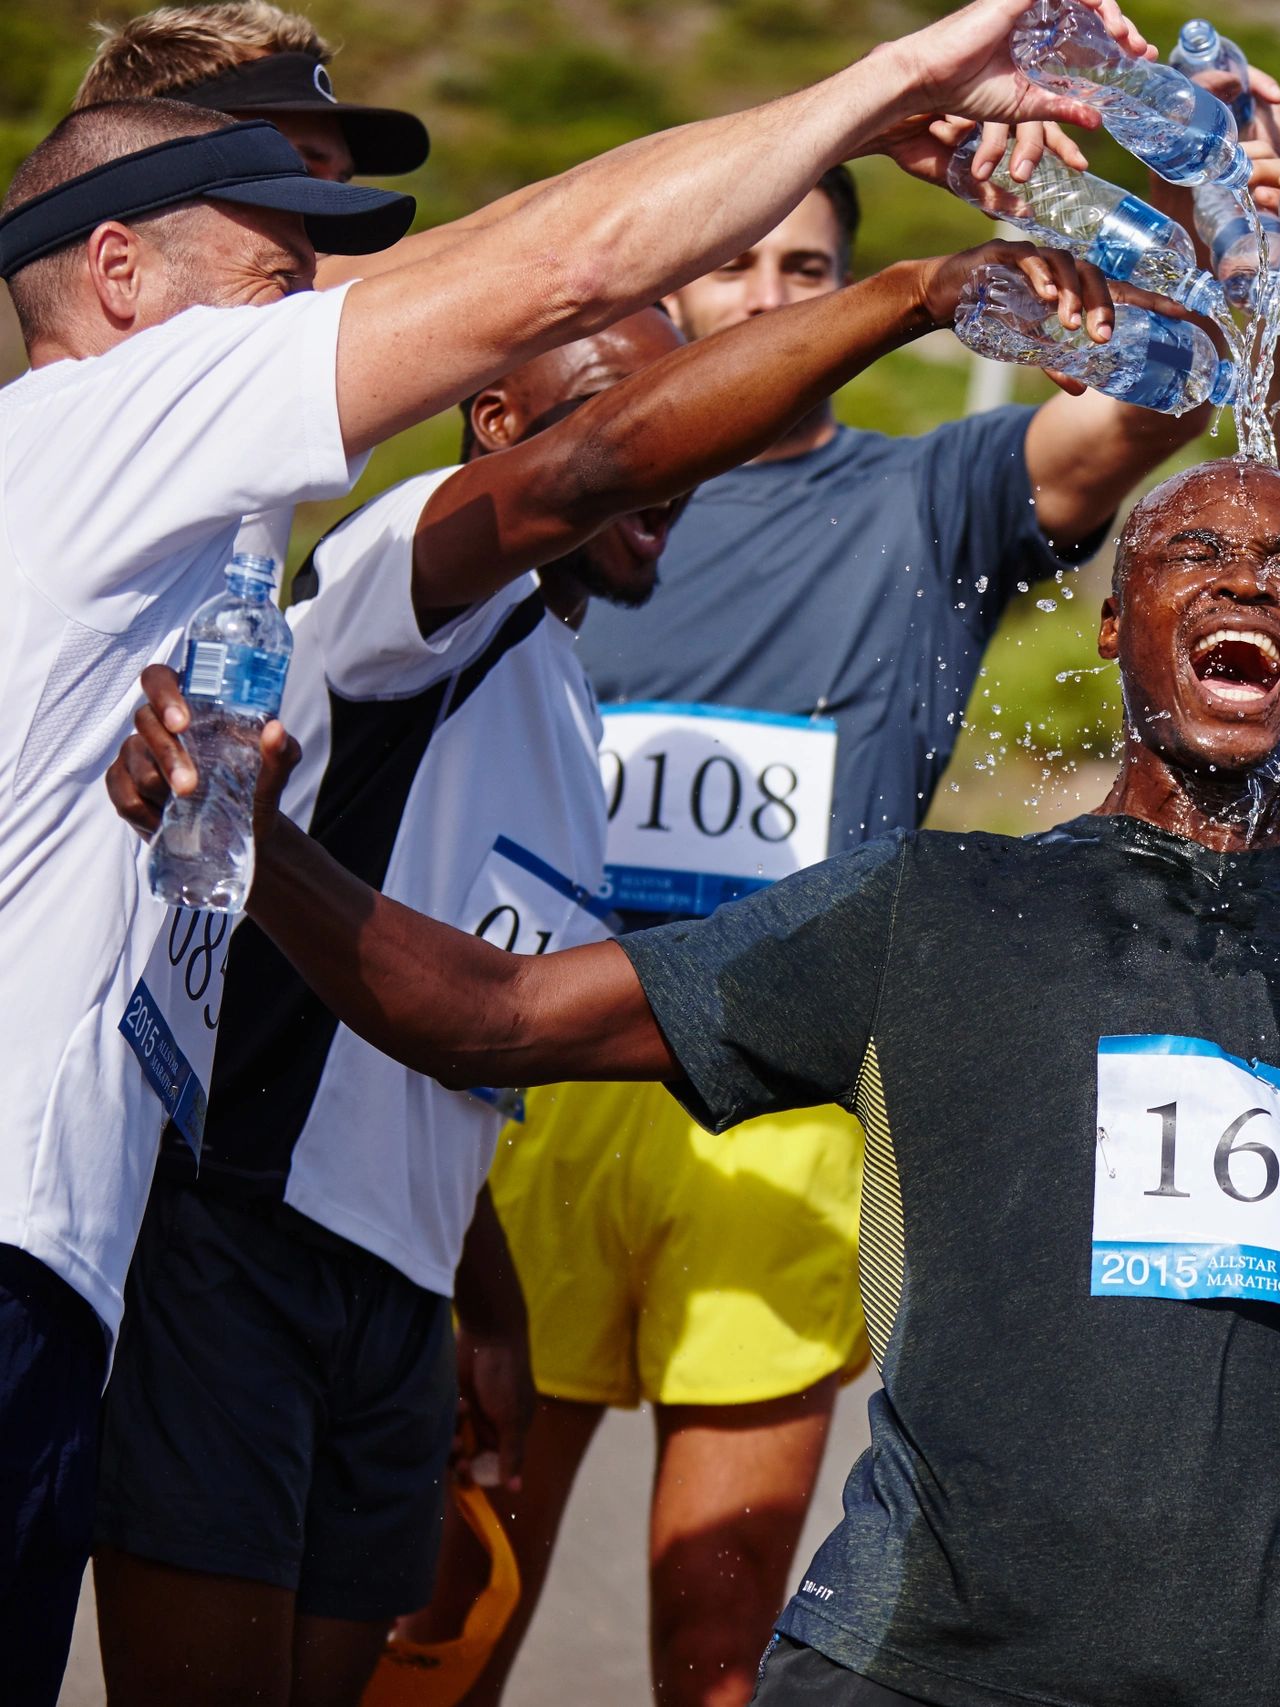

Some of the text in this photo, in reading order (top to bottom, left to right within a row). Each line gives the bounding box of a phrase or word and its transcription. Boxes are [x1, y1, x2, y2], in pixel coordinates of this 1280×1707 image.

[126, 995, 160, 1058] 2015
[1101, 1253, 1277, 1289] 2015 ALLSTAR
